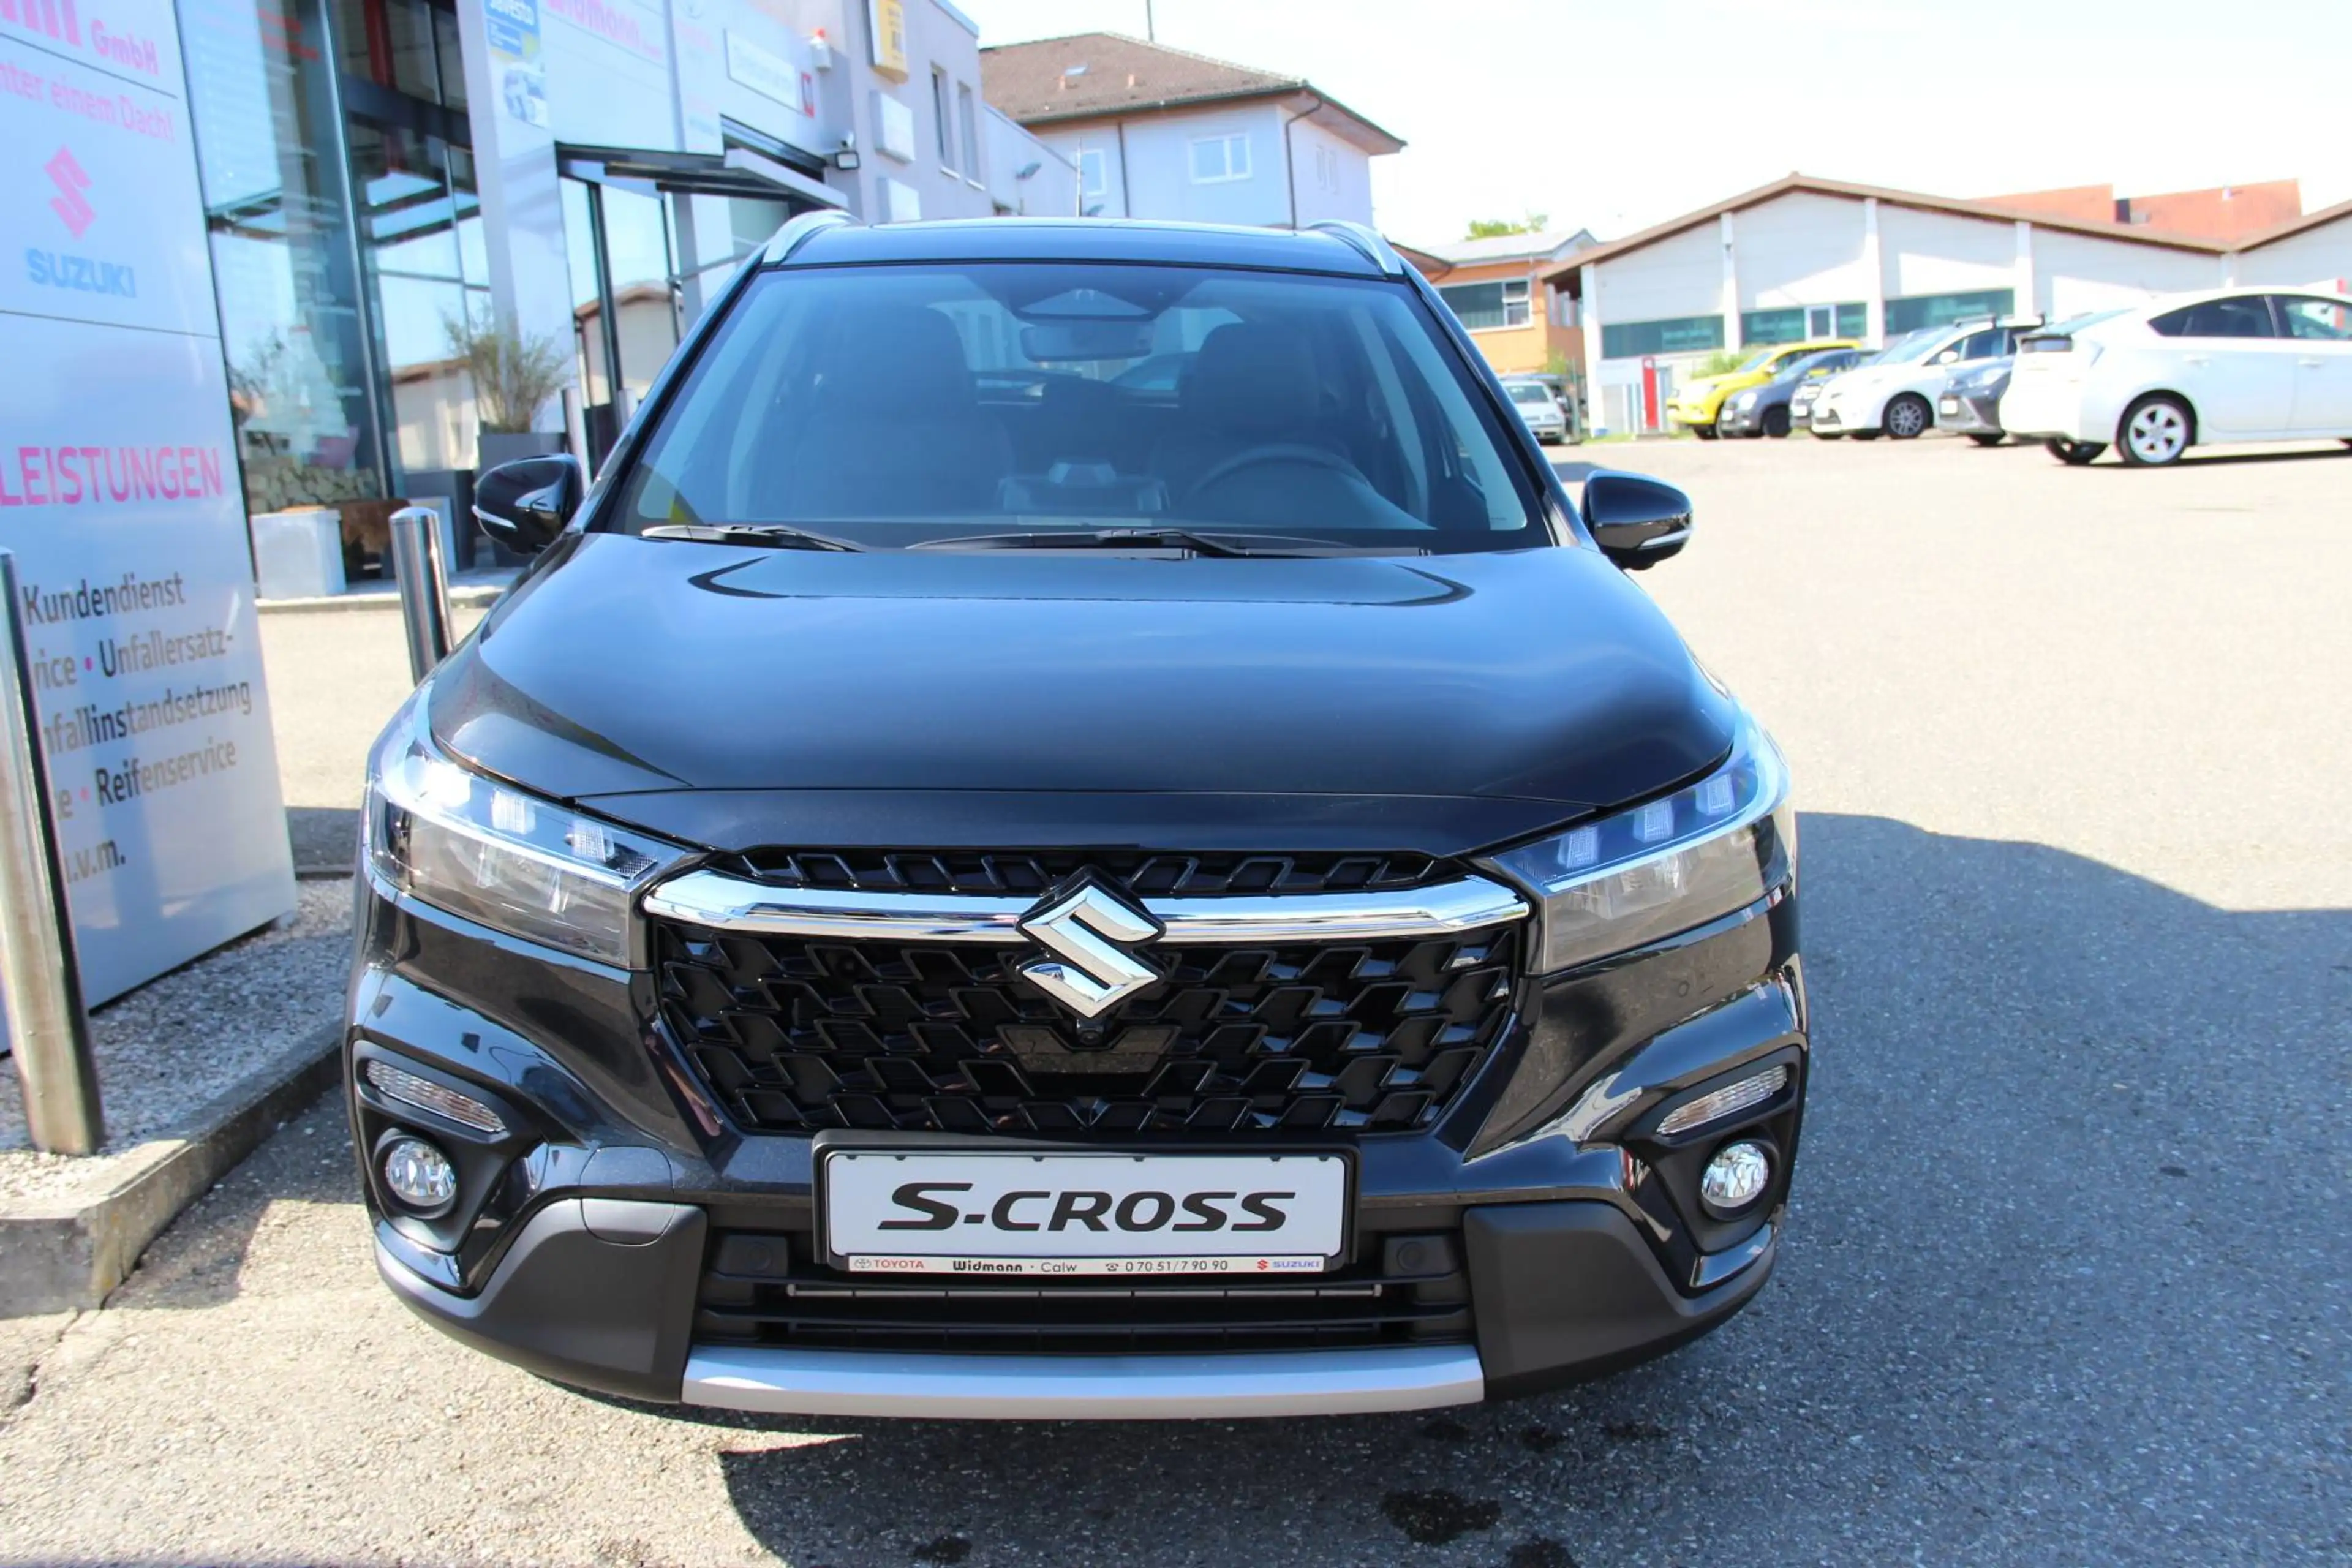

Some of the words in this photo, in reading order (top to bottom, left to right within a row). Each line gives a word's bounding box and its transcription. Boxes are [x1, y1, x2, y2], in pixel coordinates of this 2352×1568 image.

[90, 18, 159, 76] GmbH
[51, 75, 117, 124] einem
[26, 247, 136, 298] SUZUKI
[0, 445, 222, 506] LEISTUNGEN
[22, 572, 186, 625] Kundendienst
[98, 625, 233, 677] Unfallersatz-
[95, 736, 238, 807] Reifenservice
[876, 1182, 1296, 1232] S-CROSS
[873, 1259, 924, 1269] TOYOTA
[952, 1260, 1022, 1272] Widmann
[1041, 1261, 1078, 1273] Calw
[1272, 1259, 1320, 1268] SUZUKI
